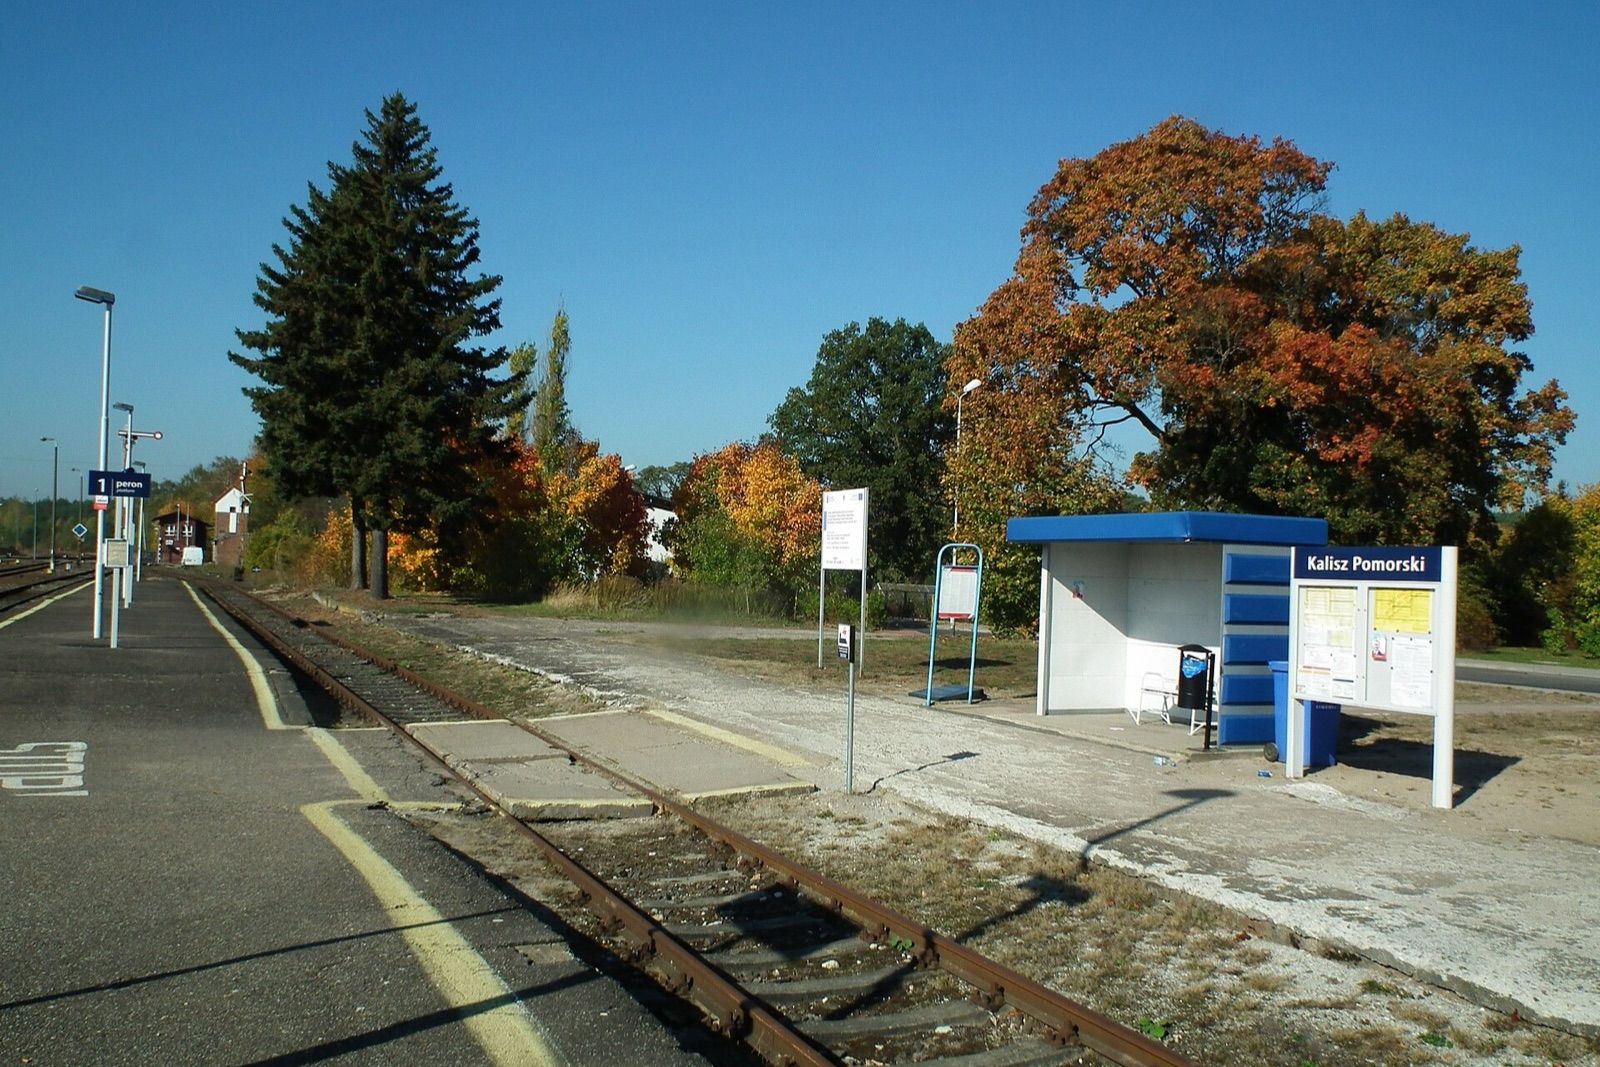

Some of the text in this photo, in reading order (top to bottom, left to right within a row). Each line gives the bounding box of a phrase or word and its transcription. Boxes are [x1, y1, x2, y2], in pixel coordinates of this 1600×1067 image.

[98, 478, 143, 492] 1 peron
[1307, 556, 1426, 572] Kalisz Pomorski
